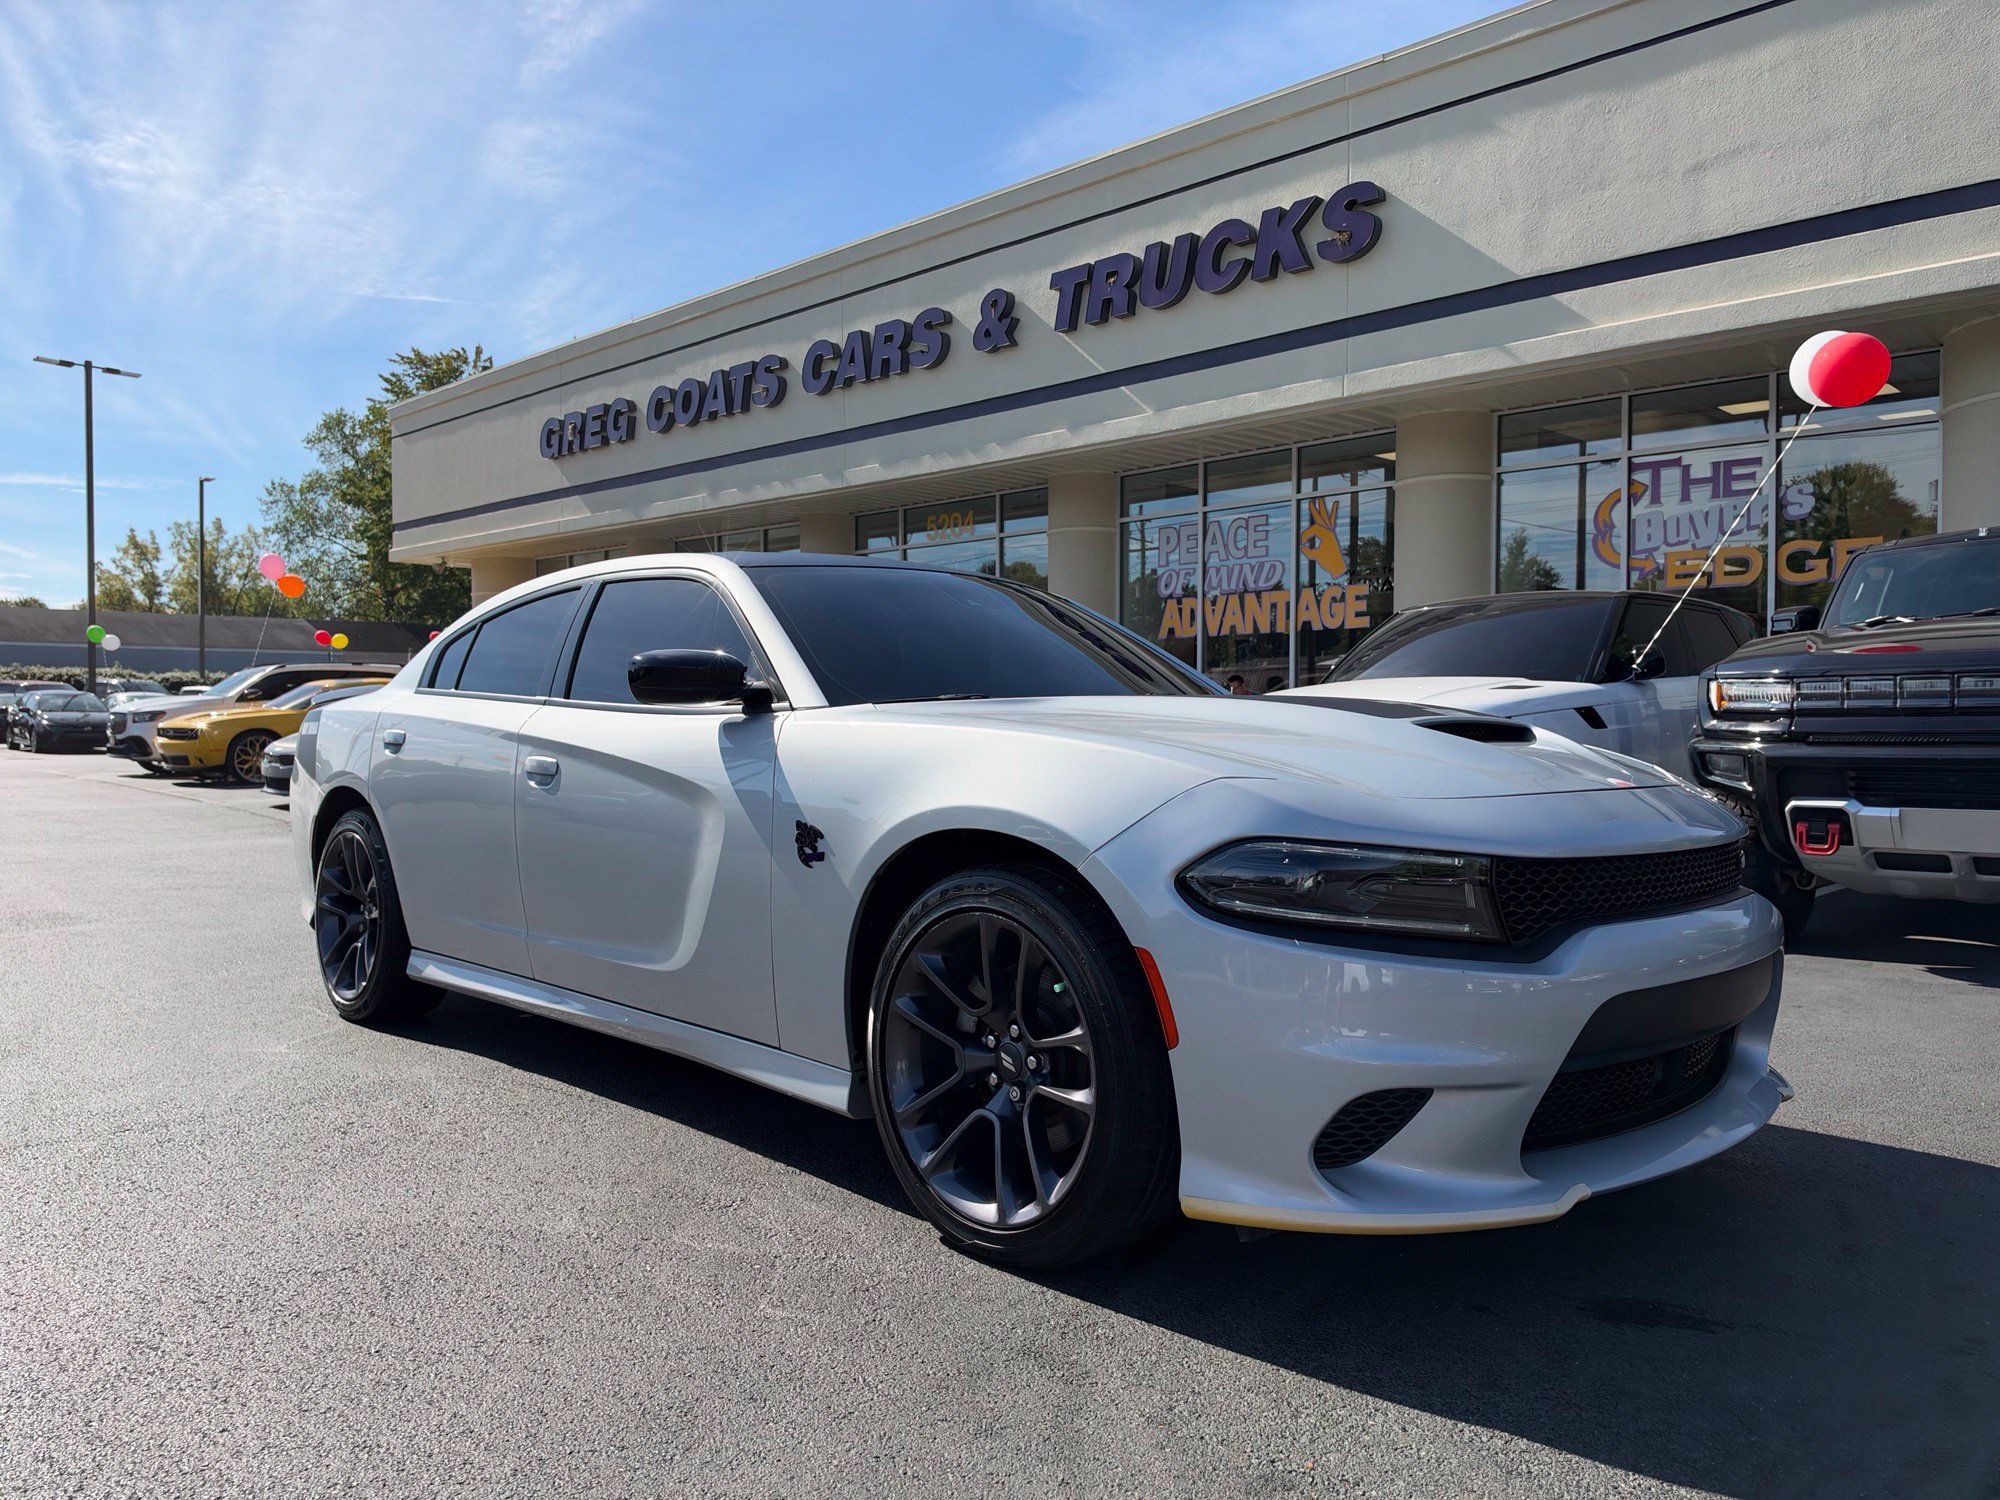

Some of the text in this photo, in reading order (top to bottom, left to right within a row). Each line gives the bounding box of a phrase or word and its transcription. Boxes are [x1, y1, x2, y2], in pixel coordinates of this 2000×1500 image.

[540, 180, 1386, 460] GREG COATS CARS & TRUCKS
[1631, 455, 1764, 507] THE
[927, 510, 975, 541] 5204
[1158, 515, 1269, 567] PEACE
[1158, 560, 1285, 598] OF MIND
[1158, 585, 1371, 640] ADVANTAGE
